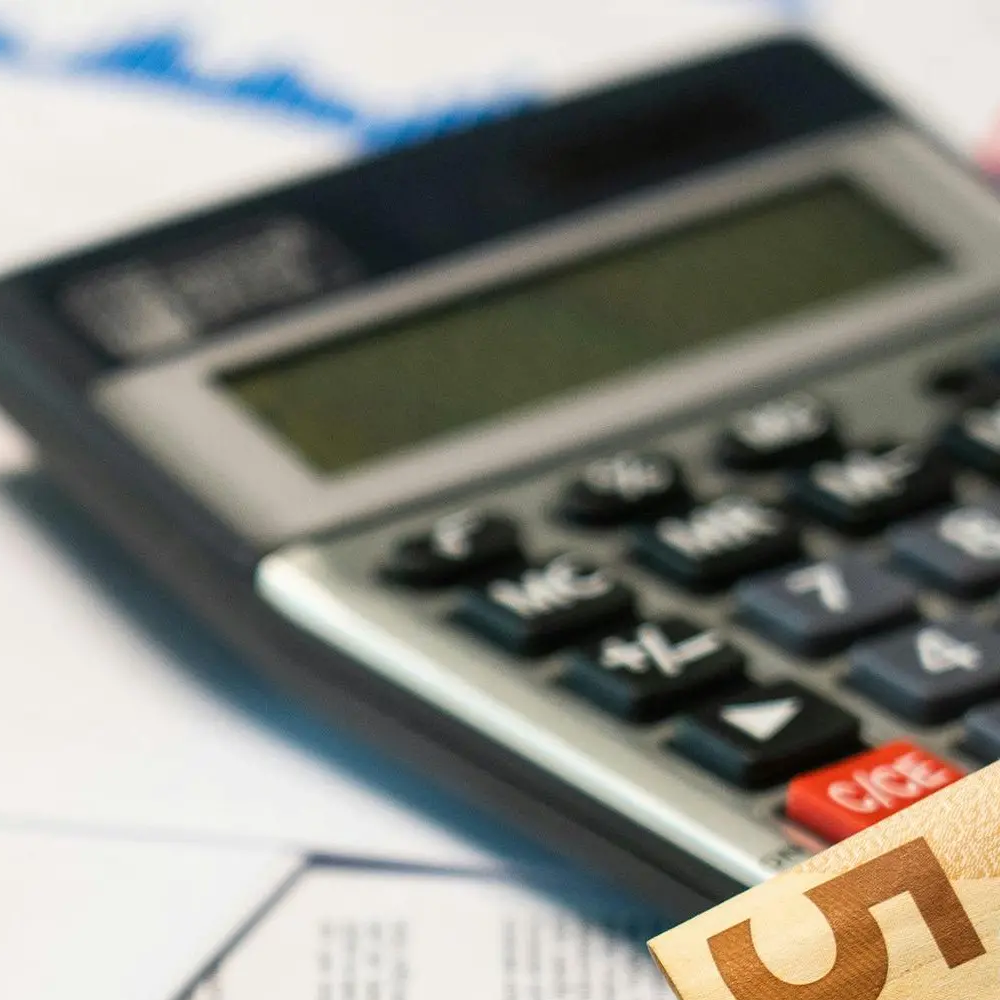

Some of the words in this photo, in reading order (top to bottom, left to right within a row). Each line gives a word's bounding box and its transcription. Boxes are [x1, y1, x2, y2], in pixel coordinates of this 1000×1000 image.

[786, 563, 850, 612] 7
[913, 626, 983, 674] 4
[827, 751, 948, 816] C/CE
